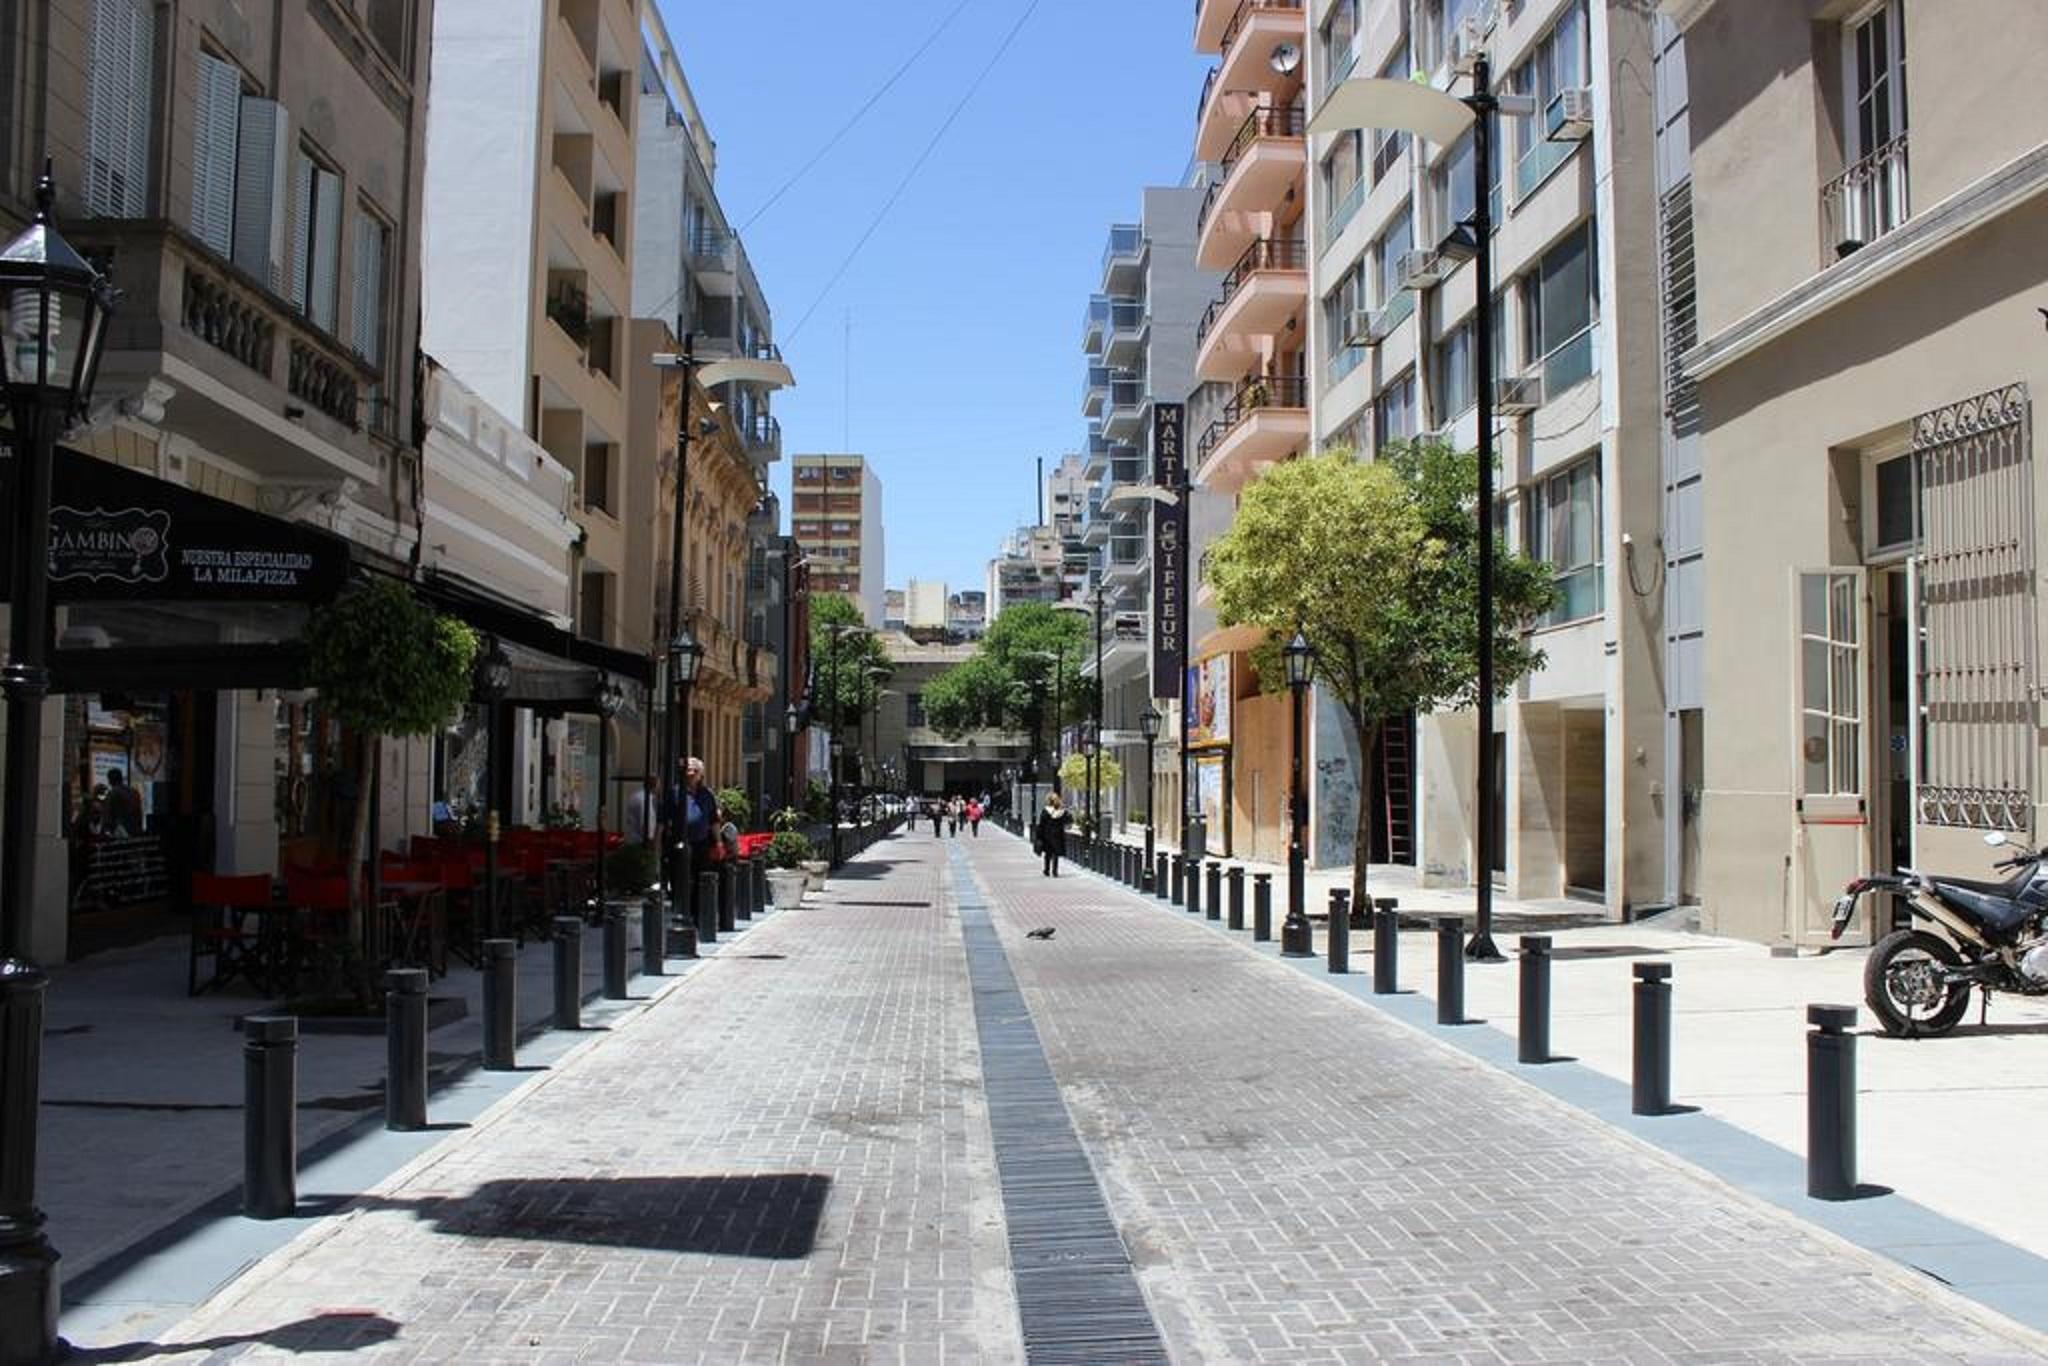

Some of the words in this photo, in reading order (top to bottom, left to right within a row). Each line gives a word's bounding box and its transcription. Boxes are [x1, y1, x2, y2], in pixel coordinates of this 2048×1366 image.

[1160, 408, 1177, 495] MARTI
[194, 567, 213, 582] LA
[217, 567, 297, 585] MILAPIZZA
[1160, 520, 1177, 651] COIFFEUR
